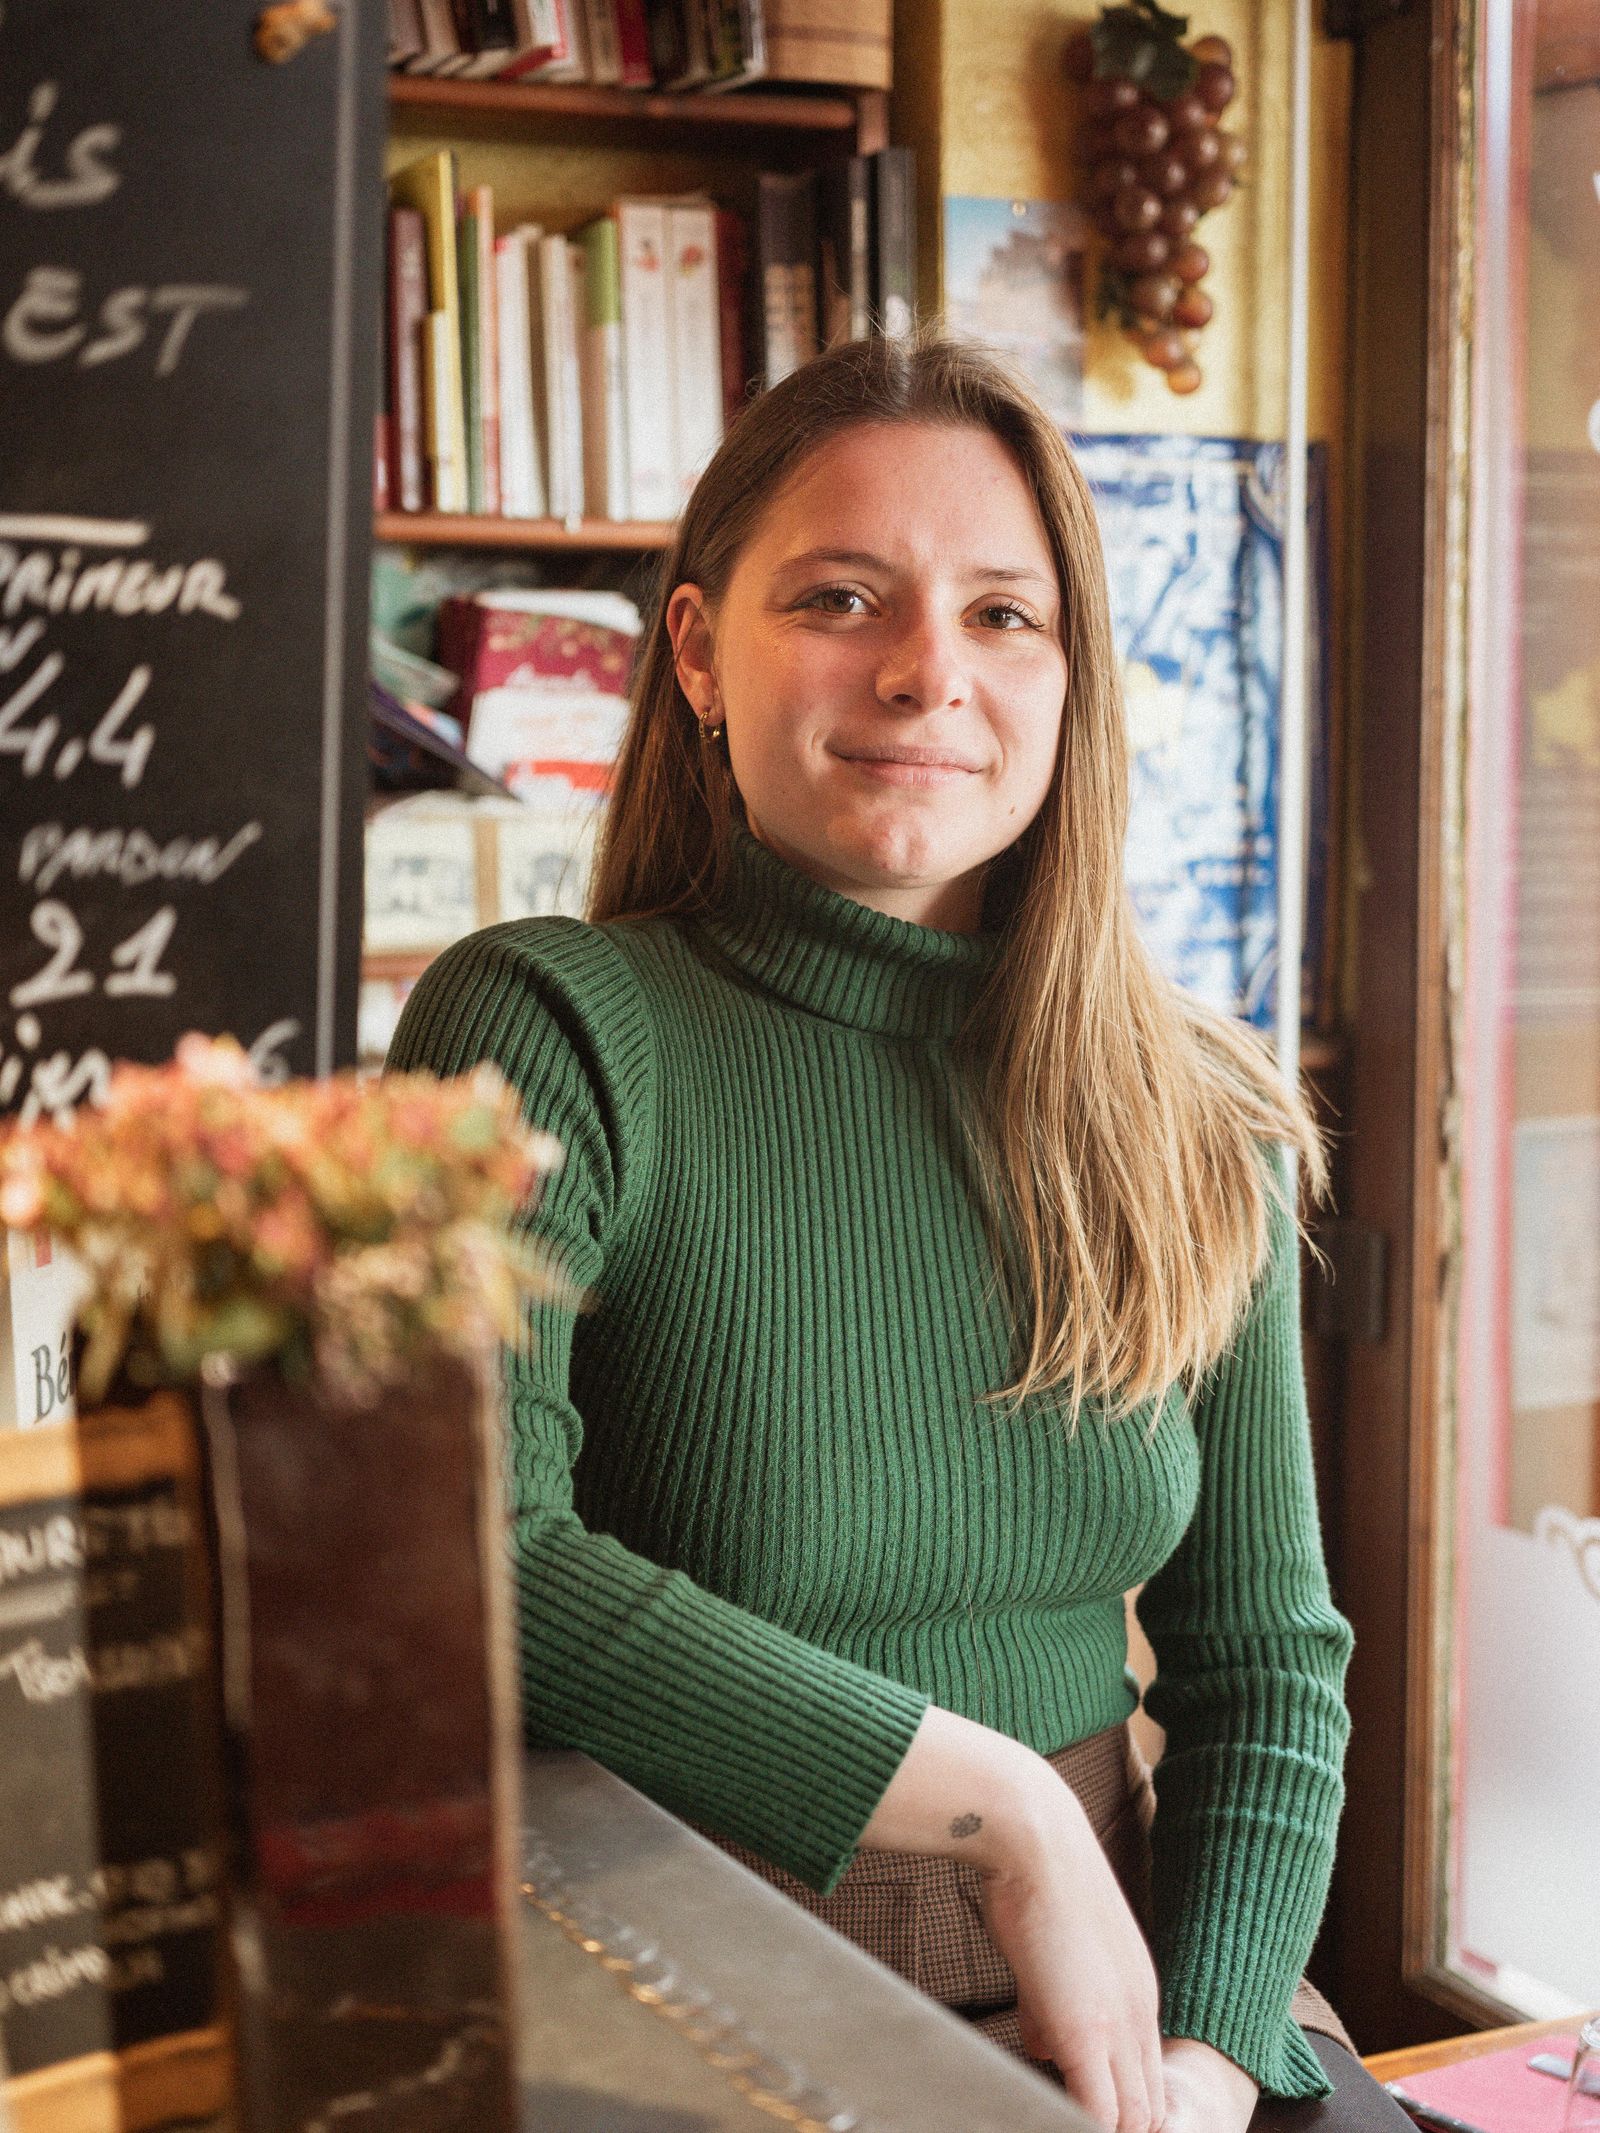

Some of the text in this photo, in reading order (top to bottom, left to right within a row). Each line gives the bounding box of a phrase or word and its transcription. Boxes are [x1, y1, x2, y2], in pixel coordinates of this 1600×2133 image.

[0, 80, 121, 206] is
[3, 265, 251, 378] EST
[31, 1331, 74, 1425] Bé
